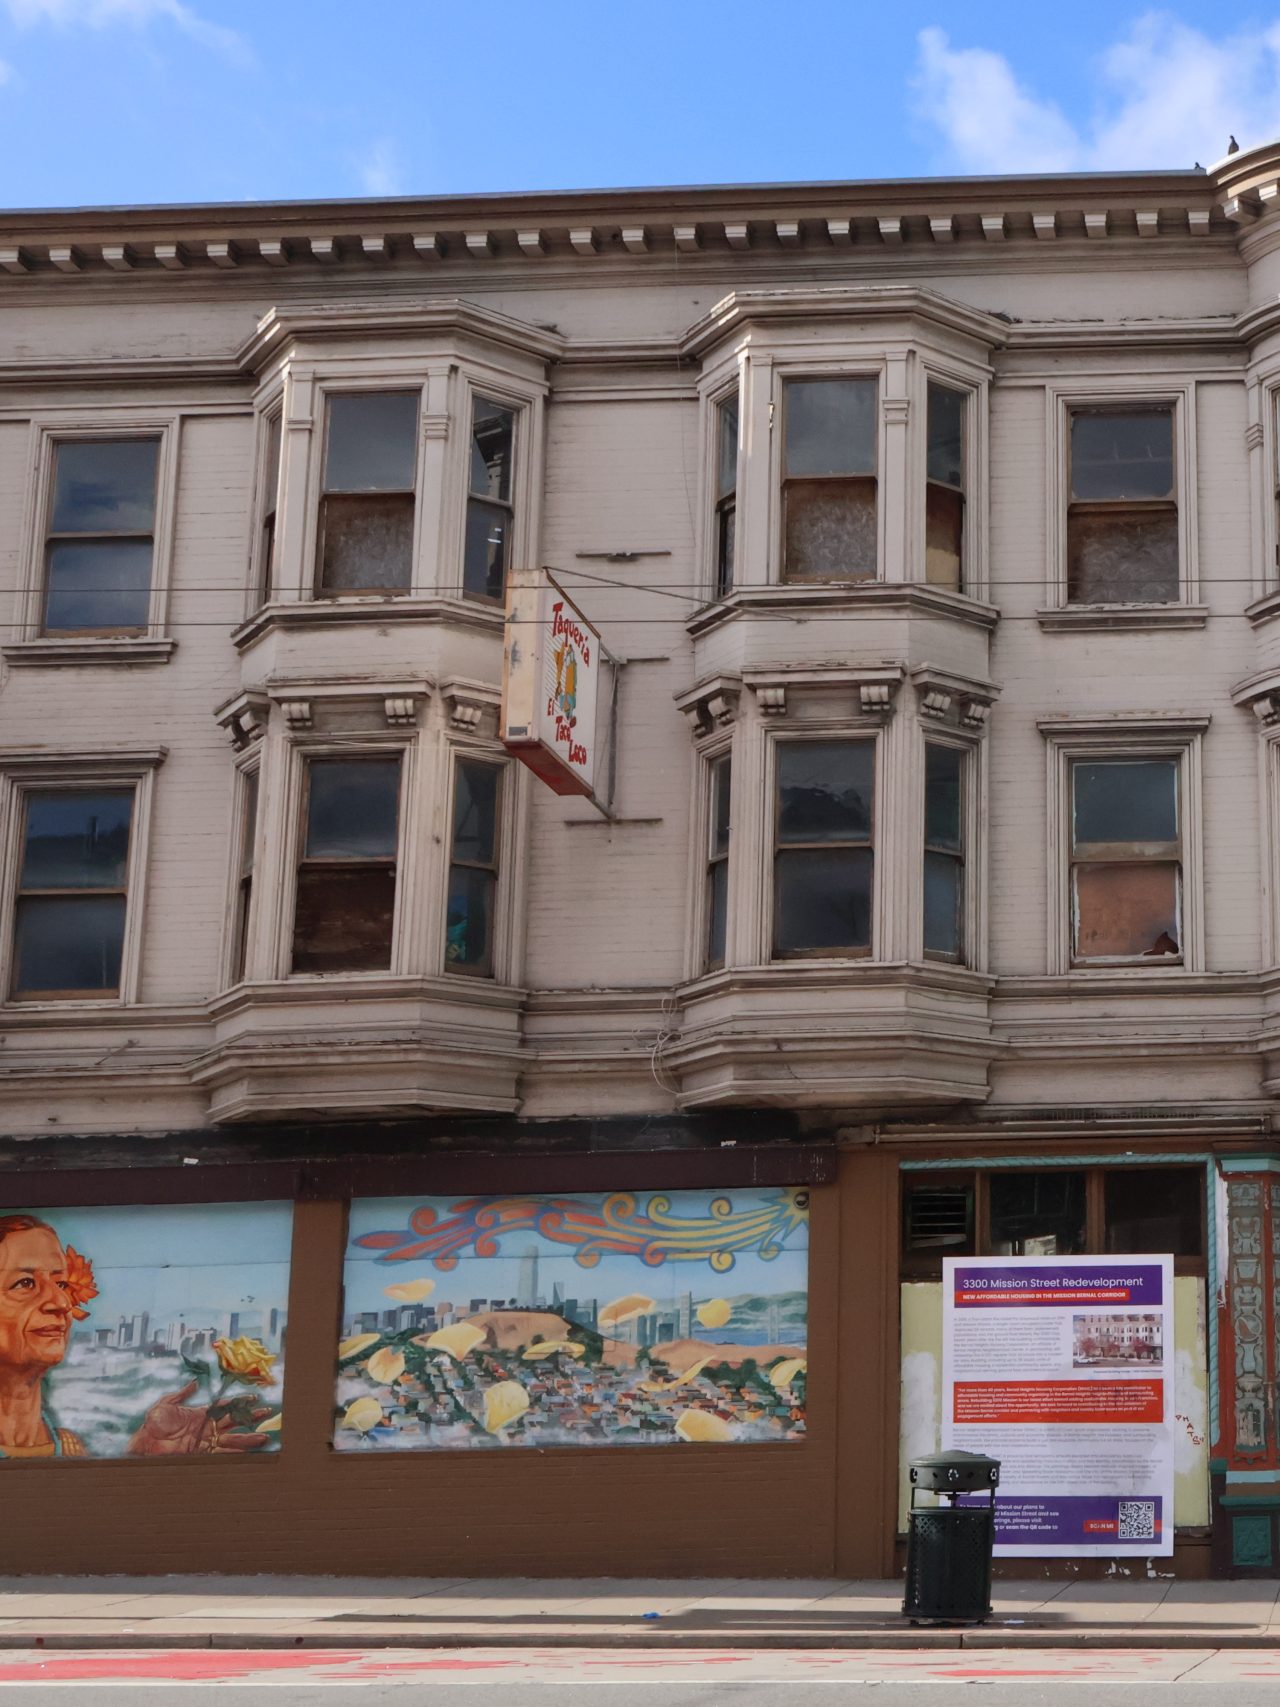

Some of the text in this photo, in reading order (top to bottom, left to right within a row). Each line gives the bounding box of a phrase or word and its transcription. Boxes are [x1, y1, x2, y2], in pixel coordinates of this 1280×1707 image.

[547, 698, 555, 717] El
[555, 716, 571, 744] Taco
[568, 741, 587, 766] Loco
[963, 1277, 1143, 1290] 3300 Mission Street Redevelopment
